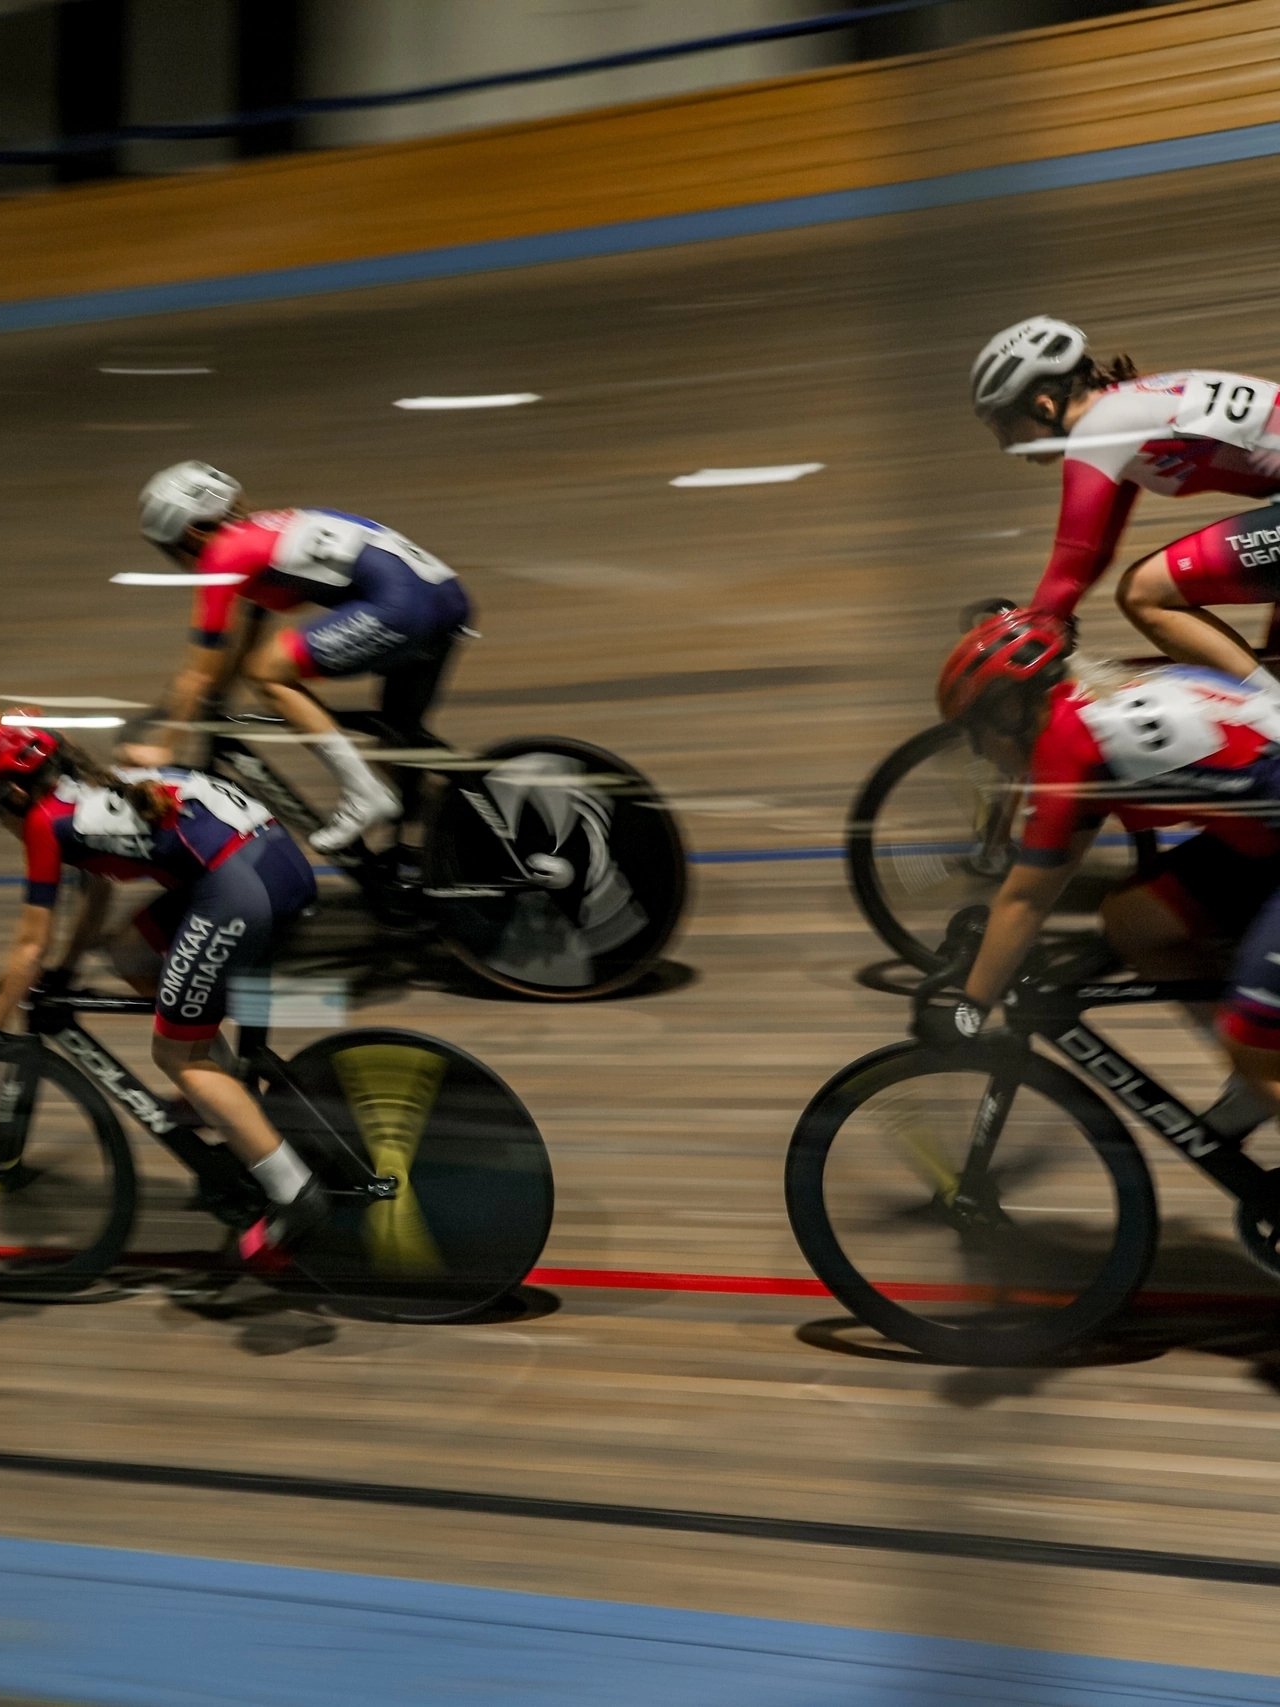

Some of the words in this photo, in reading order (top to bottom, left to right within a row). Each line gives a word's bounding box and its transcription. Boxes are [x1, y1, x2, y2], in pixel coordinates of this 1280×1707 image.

[1204, 381, 1255, 423] 10
[1225, 525, 1280, 551] ТУЛЬ
[160, 914, 214, 1006] ОМСКАЯ
[180, 918, 247, 1018] ОБЛАСТЬ
[1055, 1026, 1221, 1158] DOLAN
